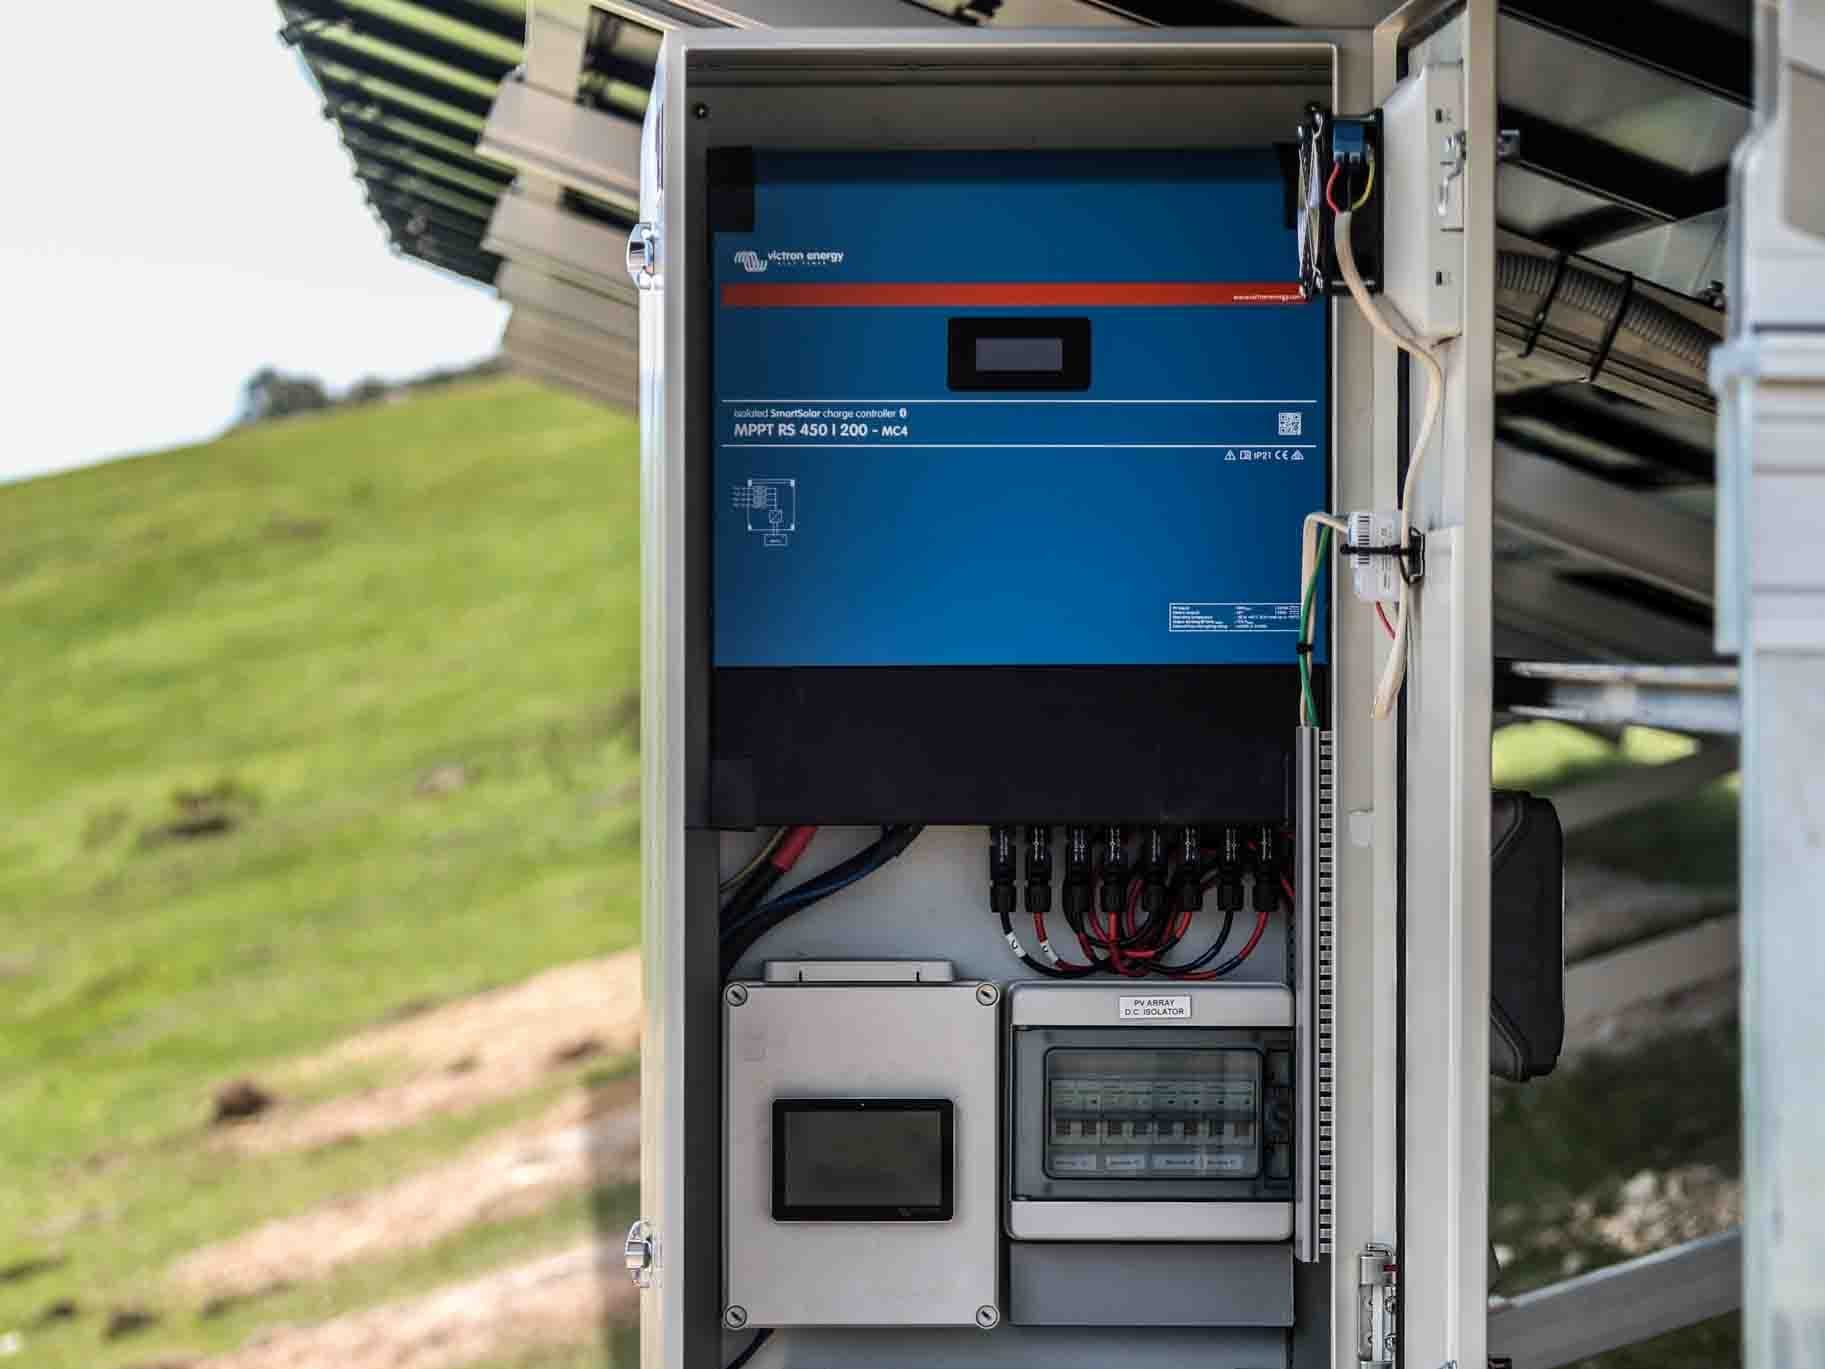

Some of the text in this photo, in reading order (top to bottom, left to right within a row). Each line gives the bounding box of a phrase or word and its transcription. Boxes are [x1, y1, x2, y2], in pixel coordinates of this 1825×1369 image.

[767, 250, 844, 263] victron energy
[770, 408, 821, 418] SmartSolar
[822, 408, 853, 420] charge
[855, 408, 896, 418] controller
[734, 423, 775, 437] MPPT
[778, 423, 796, 437] RS
[799, 423, 828, 437] 450
[840, 423, 868, 437] 200
[881, 425, 908, 437] MC4
[1133, 999, 1175, 1007] PV ARRAY
[1143, 1008, 1185, 1016] ISOLATOR
